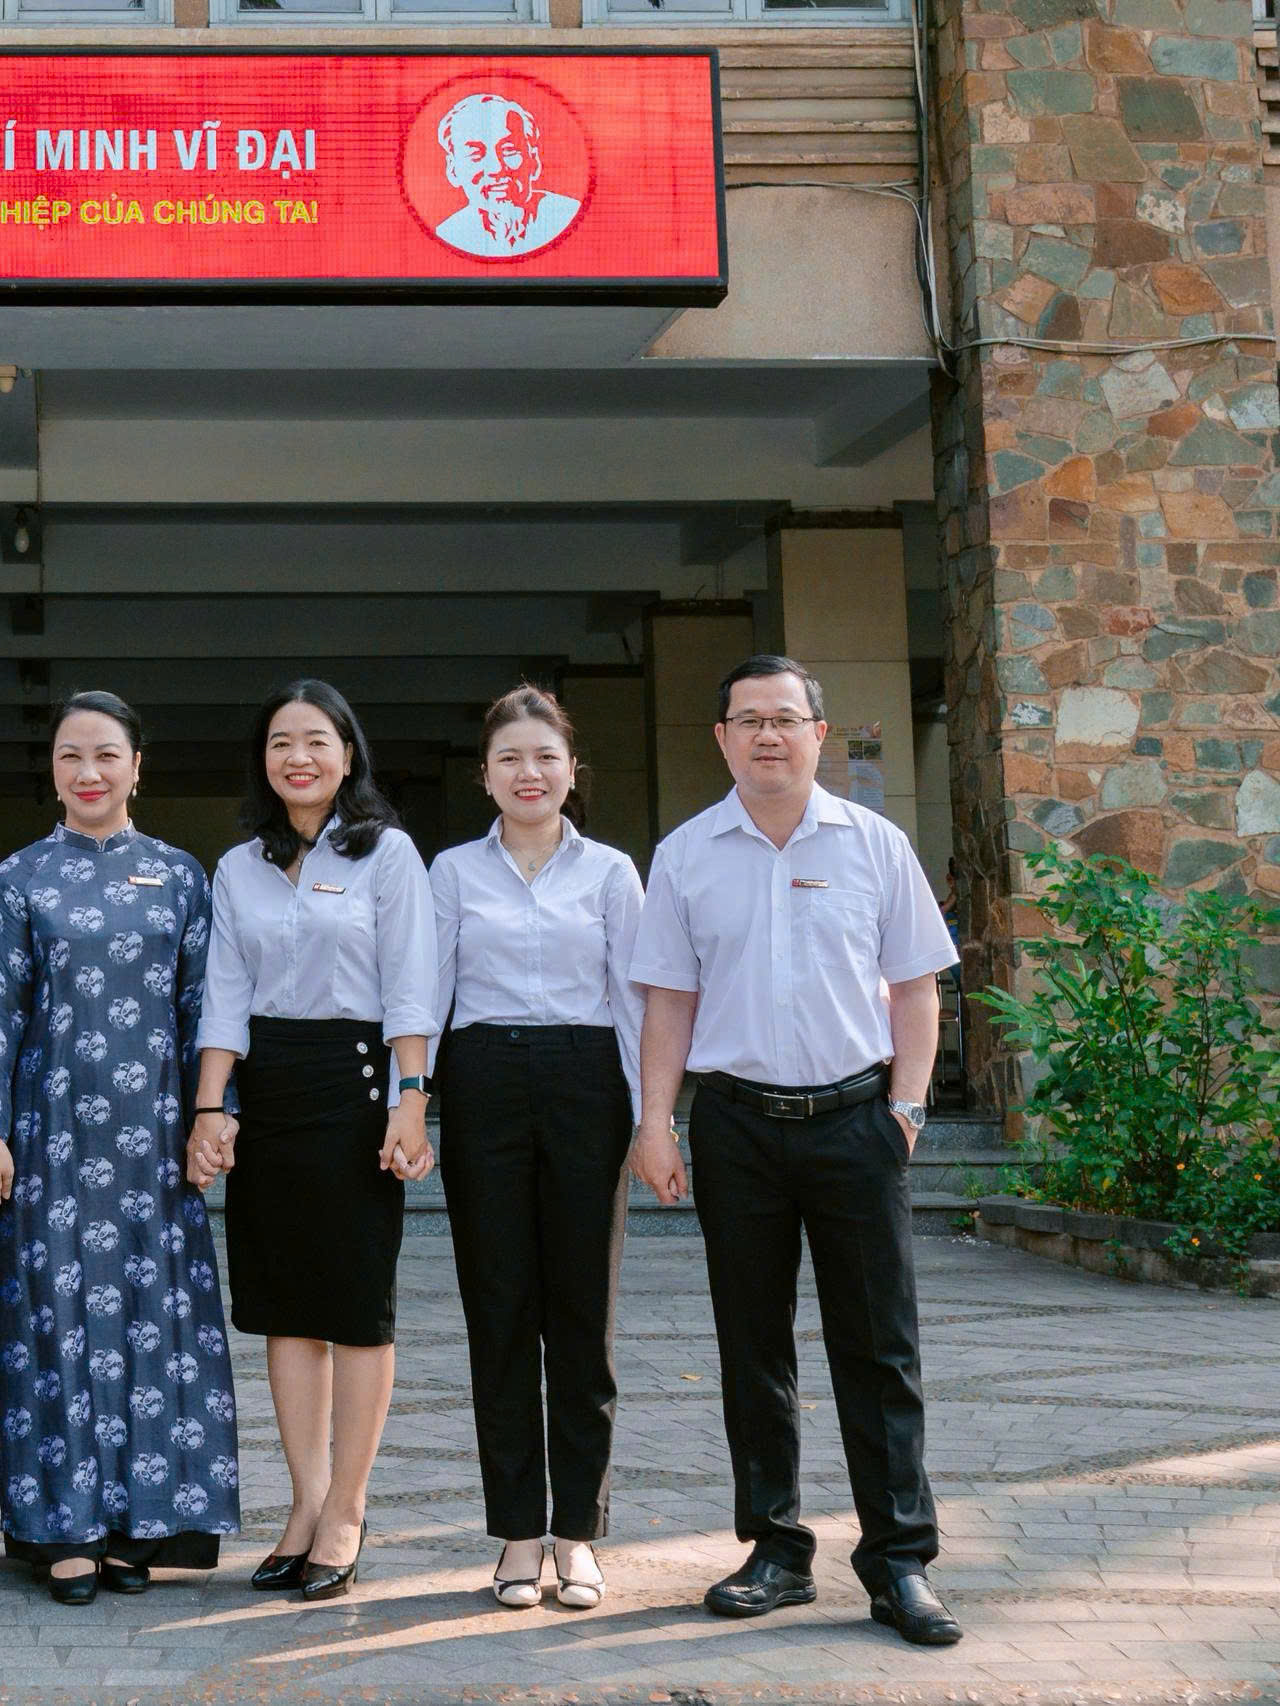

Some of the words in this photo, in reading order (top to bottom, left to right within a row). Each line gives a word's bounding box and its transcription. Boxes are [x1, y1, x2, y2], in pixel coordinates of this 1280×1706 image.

[36, 129, 157, 171] MINH
[173, 120, 221, 171] VĨ
[235, 129, 316, 179] ĐẠI
[79, 193, 145, 225] CỦA
[153, 193, 265, 225] CHÚNG
